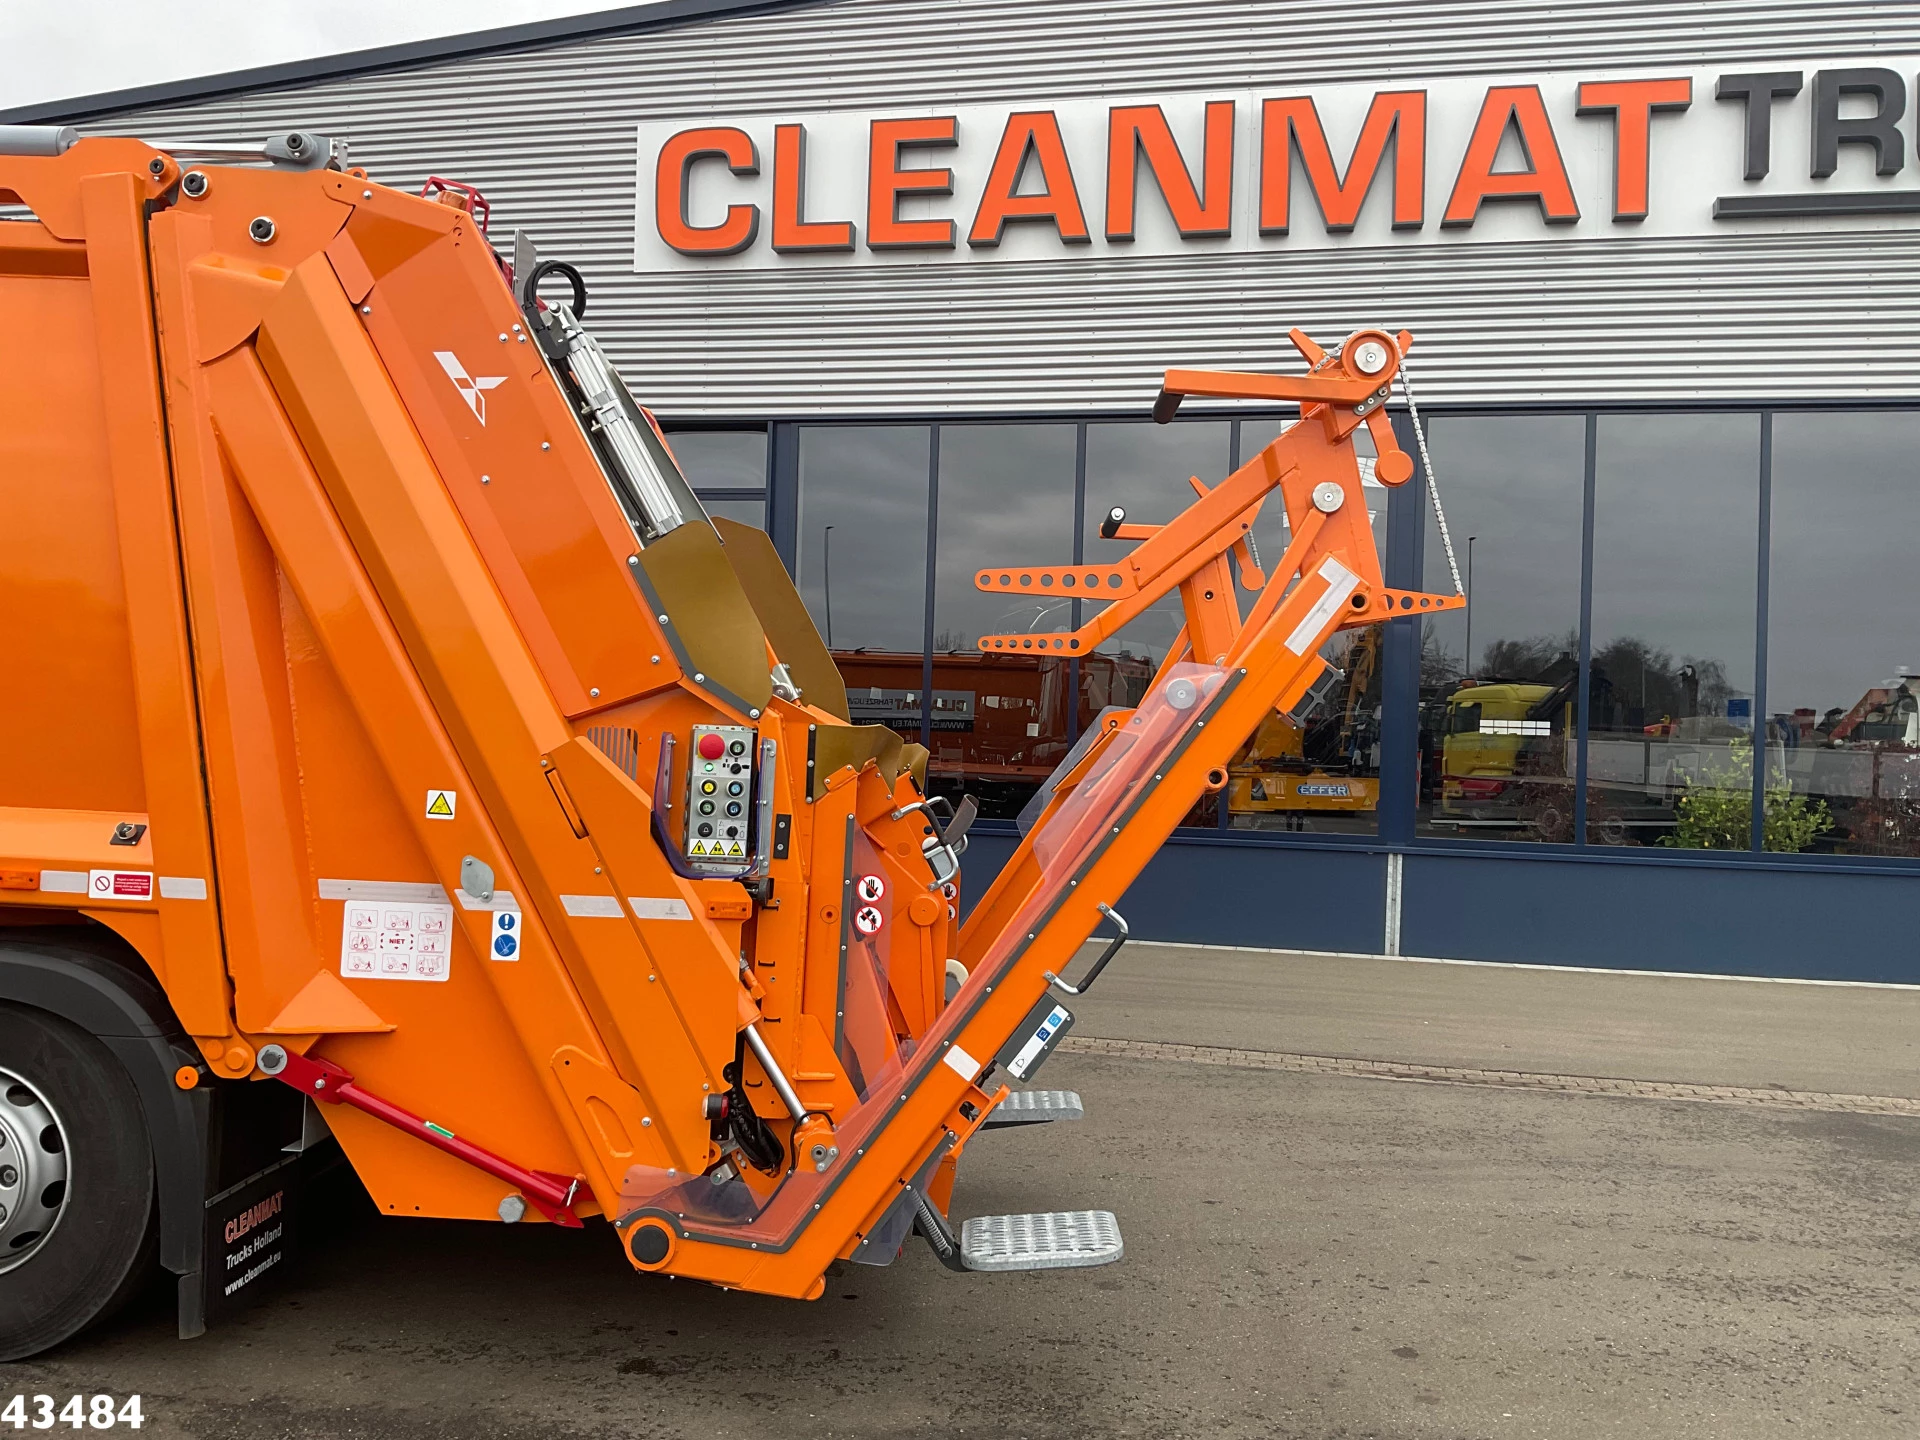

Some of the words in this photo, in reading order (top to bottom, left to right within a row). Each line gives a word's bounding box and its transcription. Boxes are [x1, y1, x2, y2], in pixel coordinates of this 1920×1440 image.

[656, 76, 1693, 258] CLEANMAT
[1715, 67, 1920, 181] TR
[1300, 786, 1346, 795] EFFER
[225, 1191, 283, 1243] CLEANMAT
[226, 1245, 253, 1270] Trucks
[254, 1222, 282, 1252] Holland
[225, 1252, 281, 1295] www.cleanmat.eu
